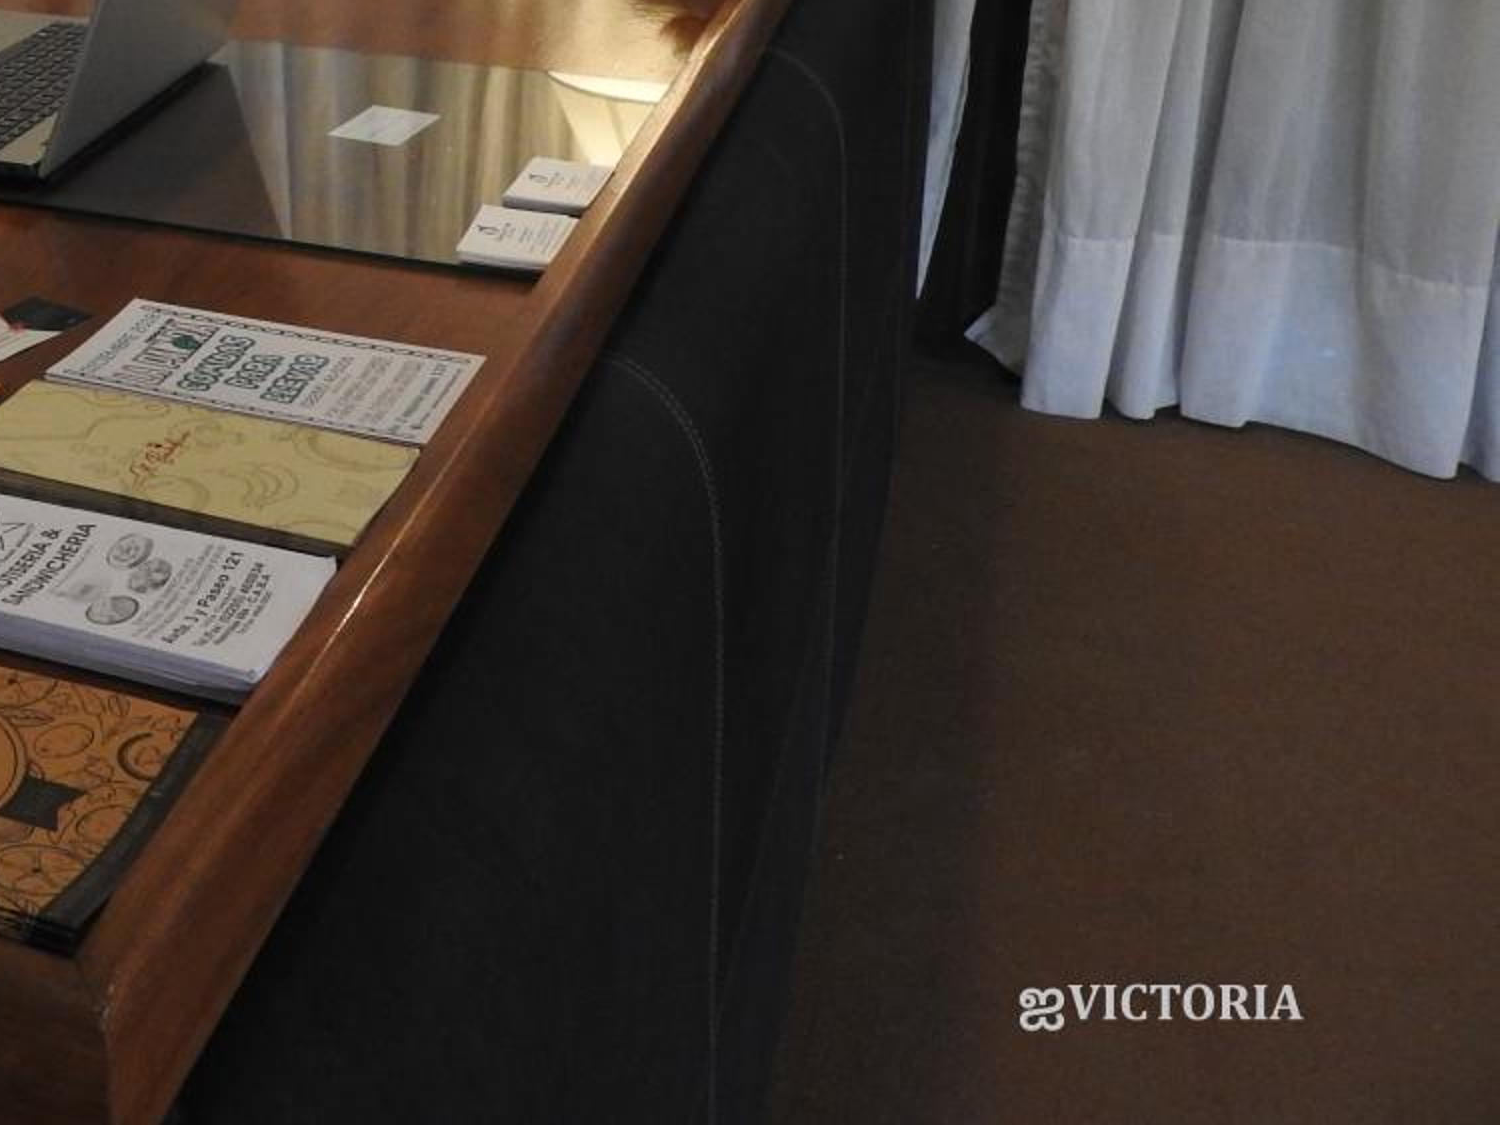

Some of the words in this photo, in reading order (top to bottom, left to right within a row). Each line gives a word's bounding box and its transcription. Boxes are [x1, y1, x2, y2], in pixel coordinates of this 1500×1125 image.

[0, 521, 98, 607] SANDWICHERIA
[44, 526, 63, 545] &
[197, 574, 231, 608] Paseo
[222, 551, 245, 571] 121
